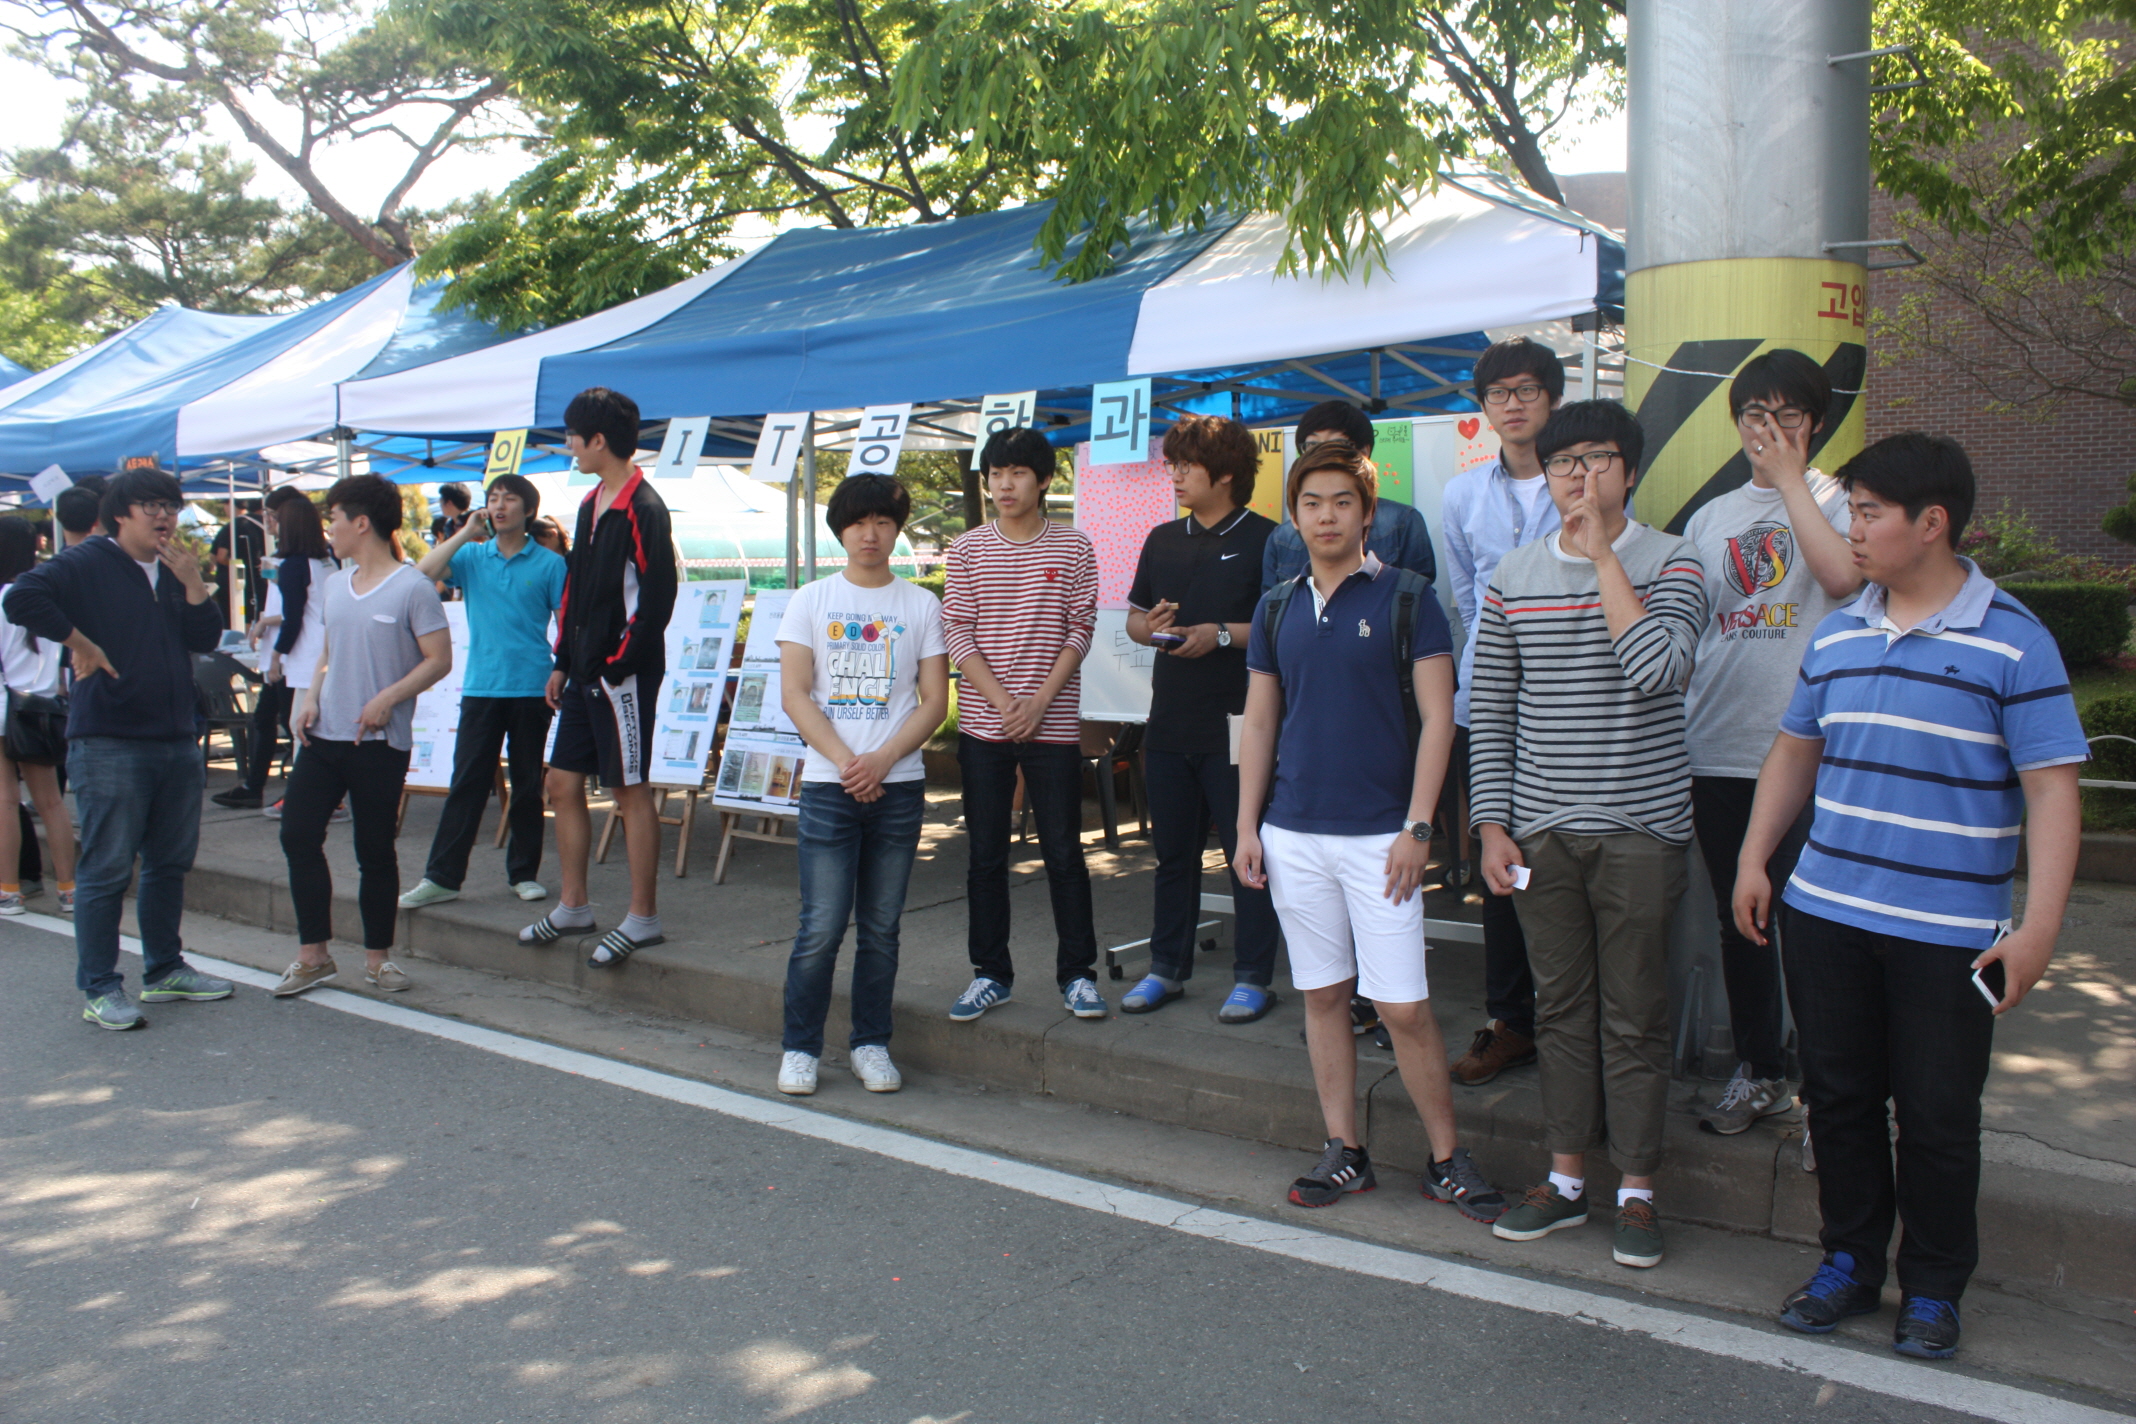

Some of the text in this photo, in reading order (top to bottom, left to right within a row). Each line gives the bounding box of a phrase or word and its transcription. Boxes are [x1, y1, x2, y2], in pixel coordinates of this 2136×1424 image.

[488, 436, 521, 474] 의
[671, 430, 692, 466] I
[773, 425, 796, 466] T
[858, 414, 901, 466] 공
[1094, 388, 1148, 451] 과
[827, 612, 843, 620] KEEP
[845, 613, 866, 622] GOING
[1742, 628, 1787, 640] COUTURE
[827, 641, 886, 652] PRIMARY SOLID COLOR
[837, 707, 864, 720] URSELF
[865, 707, 889, 720] BETTER
